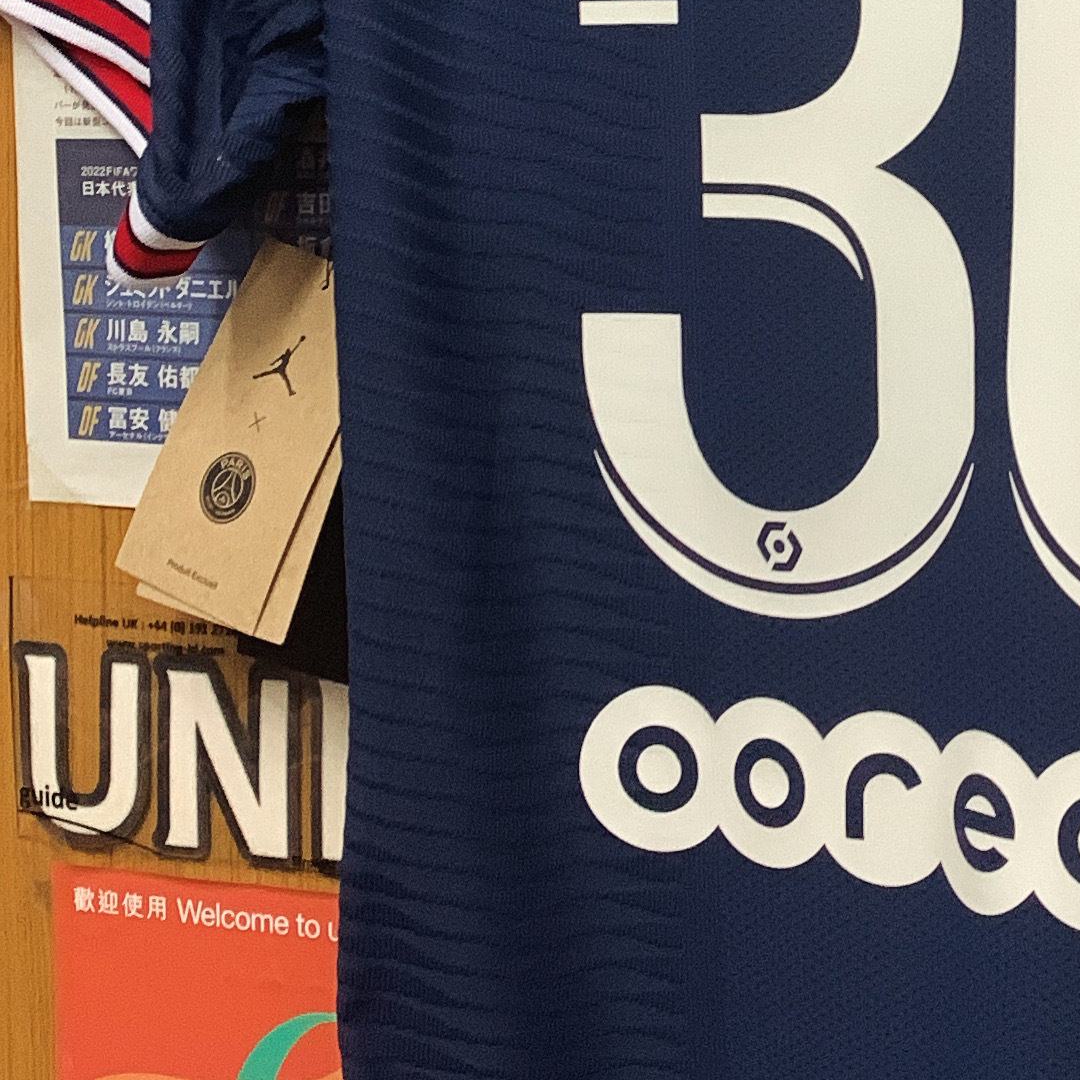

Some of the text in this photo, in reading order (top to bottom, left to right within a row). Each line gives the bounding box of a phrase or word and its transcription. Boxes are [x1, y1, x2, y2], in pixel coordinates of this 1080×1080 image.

[70, 230, 97, 261] GK
[72, 274, 98, 305] GK
[74, 318, 101, 349] GK
[106, 319, 200, 345] 川島 永嗣
[77, 361, 101, 393] DF
[106, 362, 149, 387] 長友
[78, 405, 102, 437] DF
[122, 618, 138, 629] UK
[19, 785, 79, 811] guide
[177, 897, 289, 935] Welcome
[296, 913, 321, 939] to
